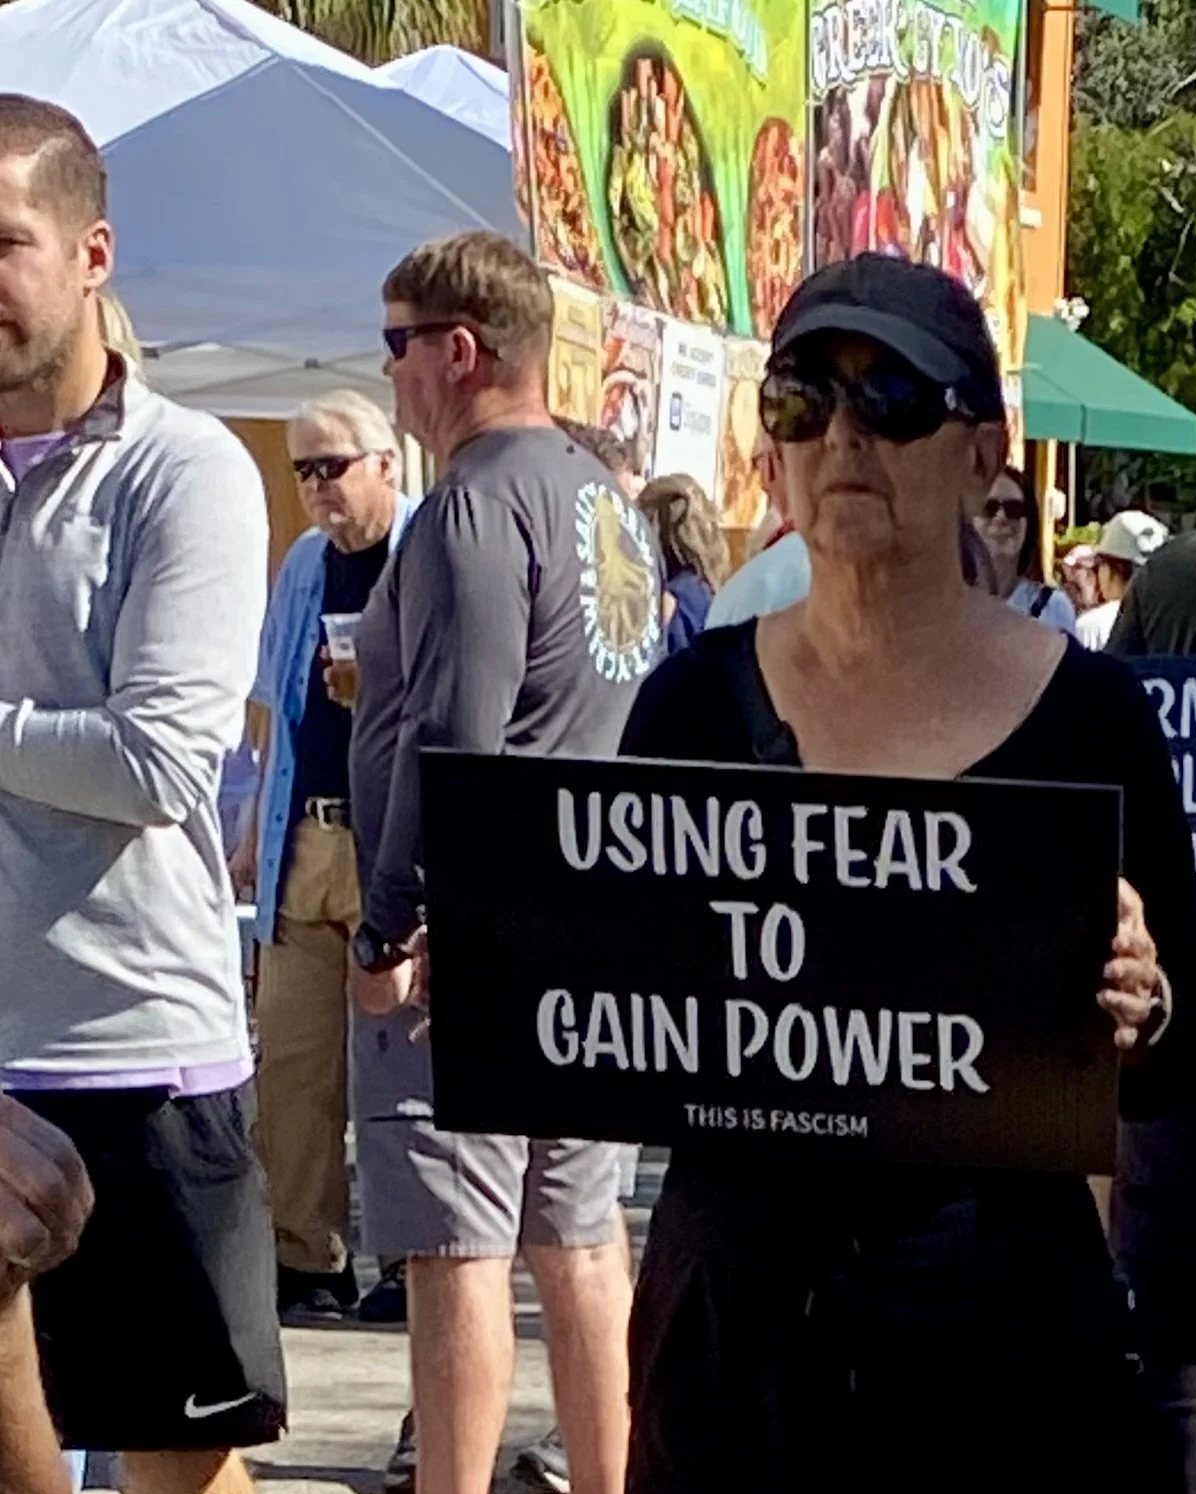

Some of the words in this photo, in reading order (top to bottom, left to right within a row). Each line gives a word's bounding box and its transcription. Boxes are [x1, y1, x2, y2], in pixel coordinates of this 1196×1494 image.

[557, 788, 767, 880] USING
[791, 803, 977, 893] FEAR
[709, 901, 806, 982] TO
[536, 988, 699, 1073] GAIN
[725, 999, 990, 1093] POWER
[684, 1104, 738, 1129] THIS
[743, 1108, 766, 1130] IS
[770, 1109, 868, 1138] FASCISM
